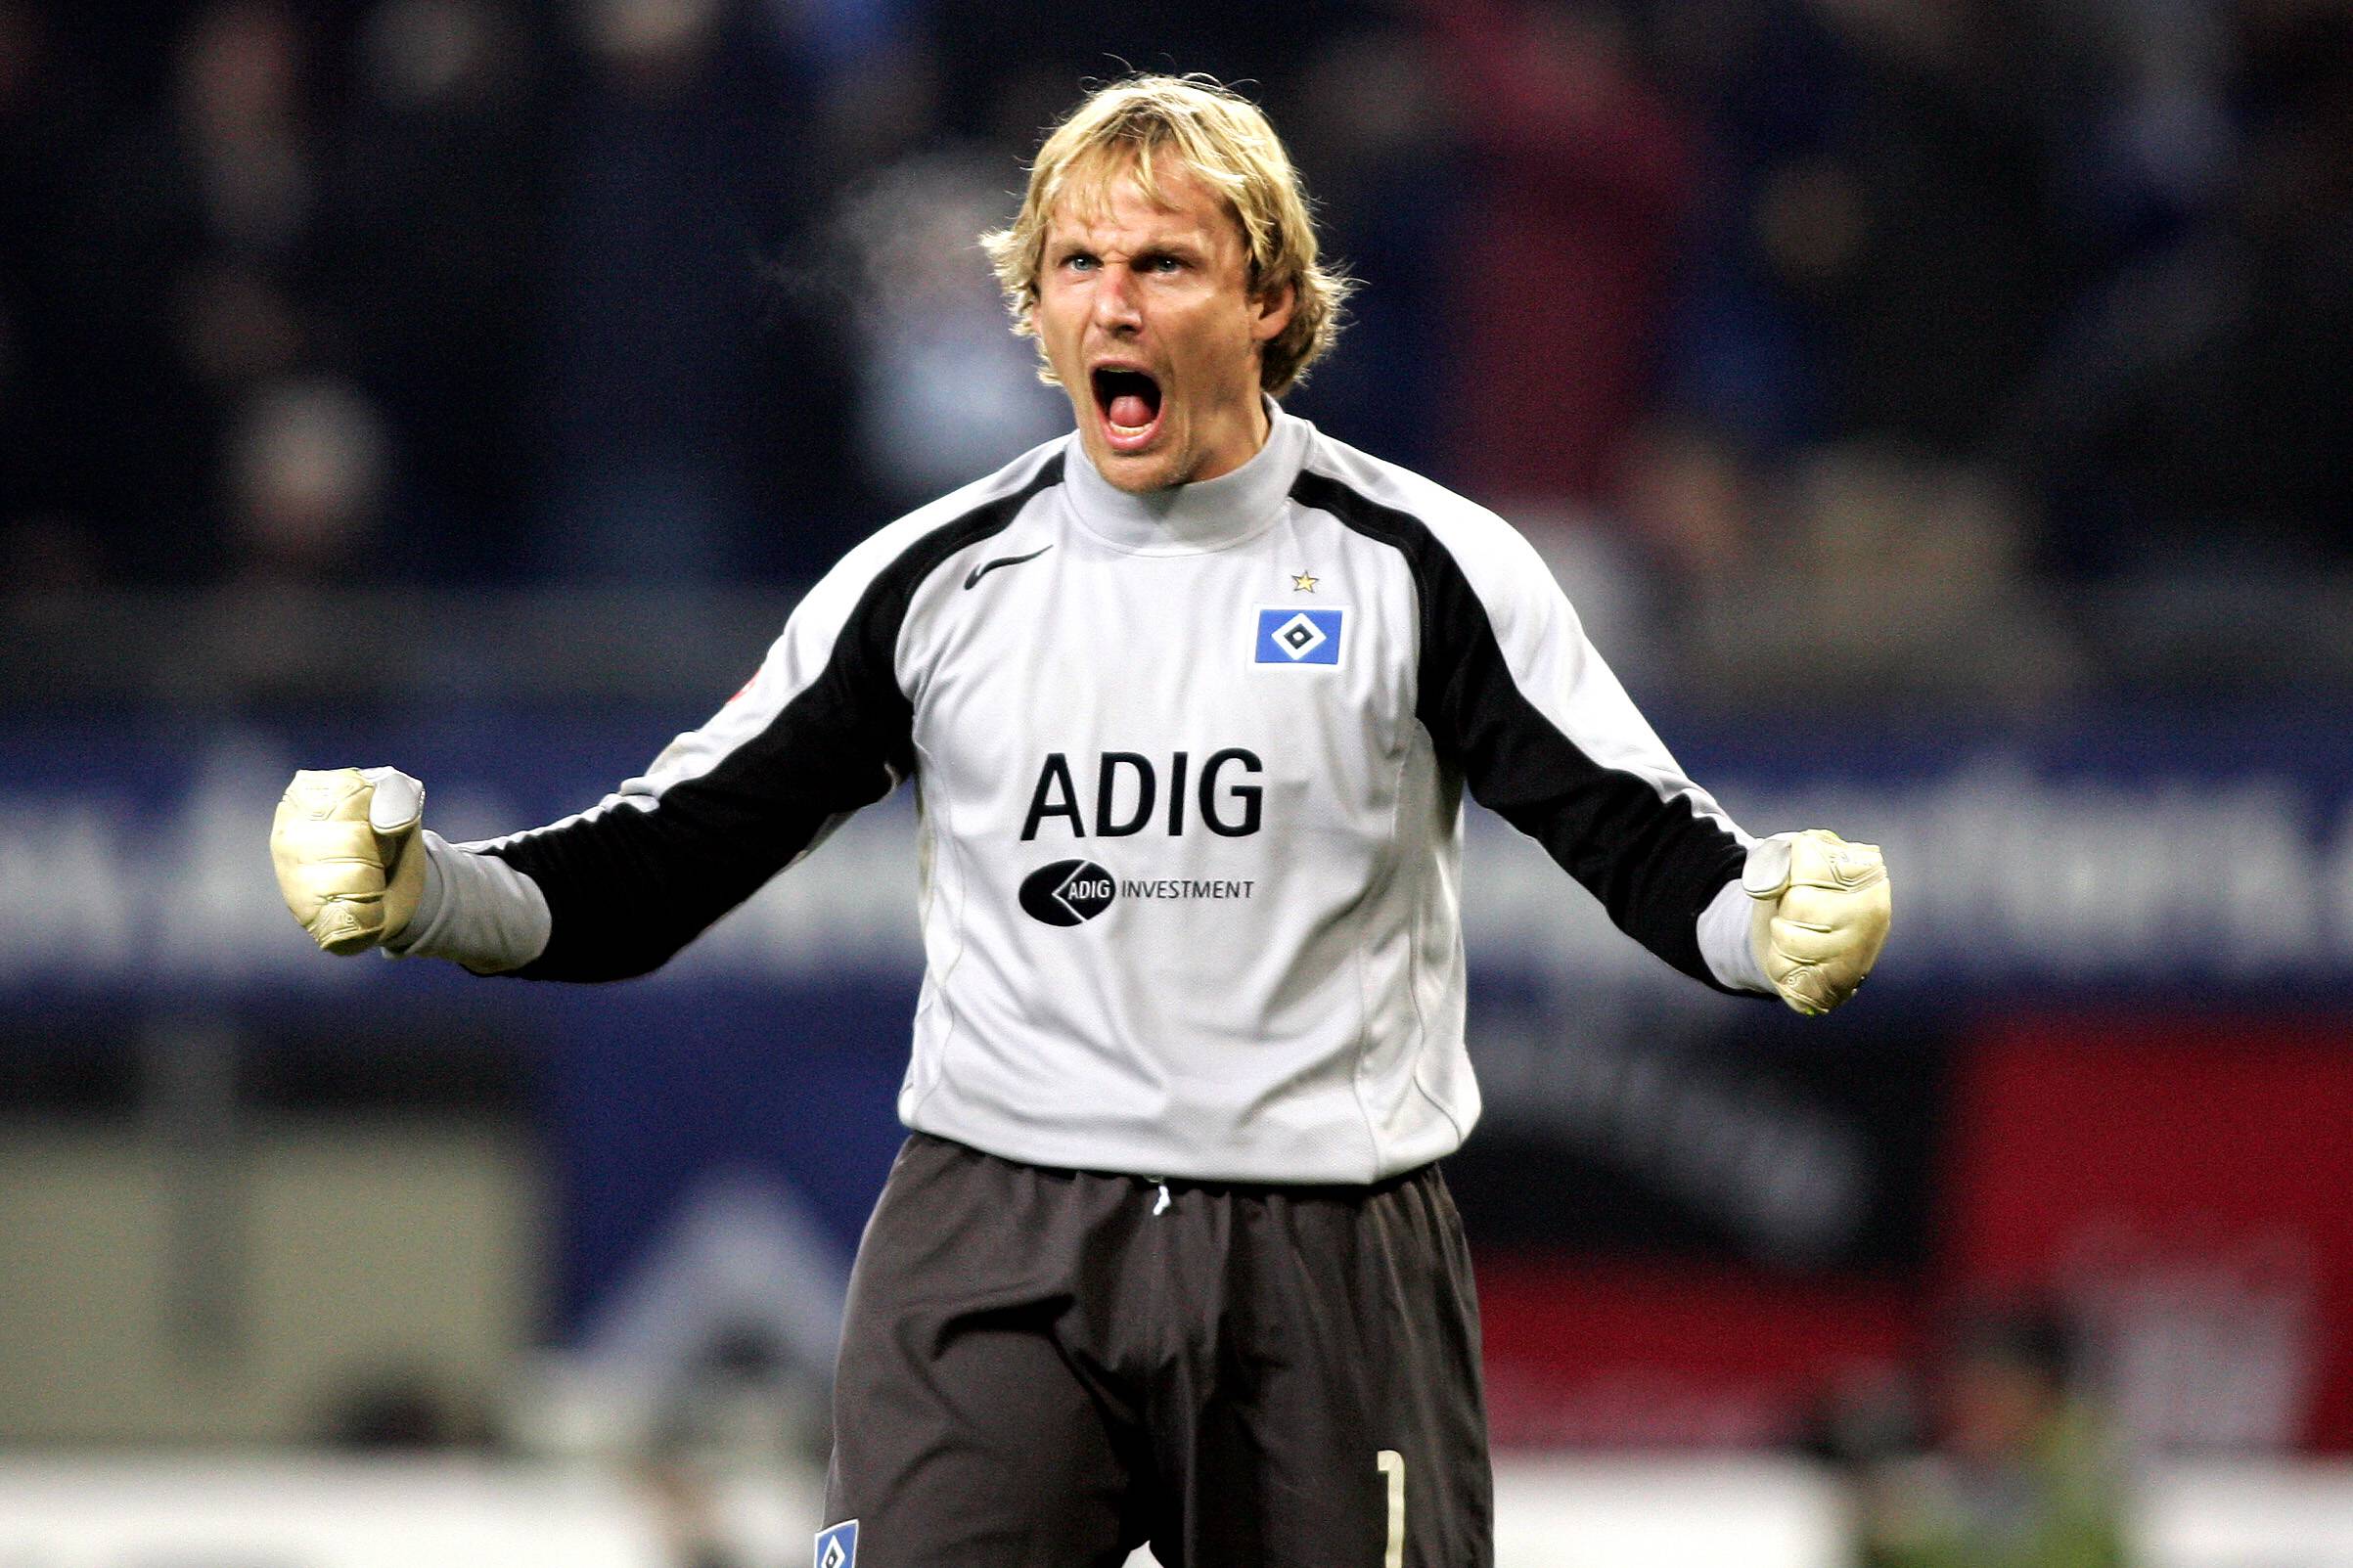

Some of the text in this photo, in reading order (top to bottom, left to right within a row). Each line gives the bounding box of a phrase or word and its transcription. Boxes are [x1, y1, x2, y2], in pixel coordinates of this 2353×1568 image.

[1020, 747, 1263, 840] ADIG
[1068, 879, 1254, 901] ADIG INVESTMENT
[1377, 1449, 1405, 1568] 1
